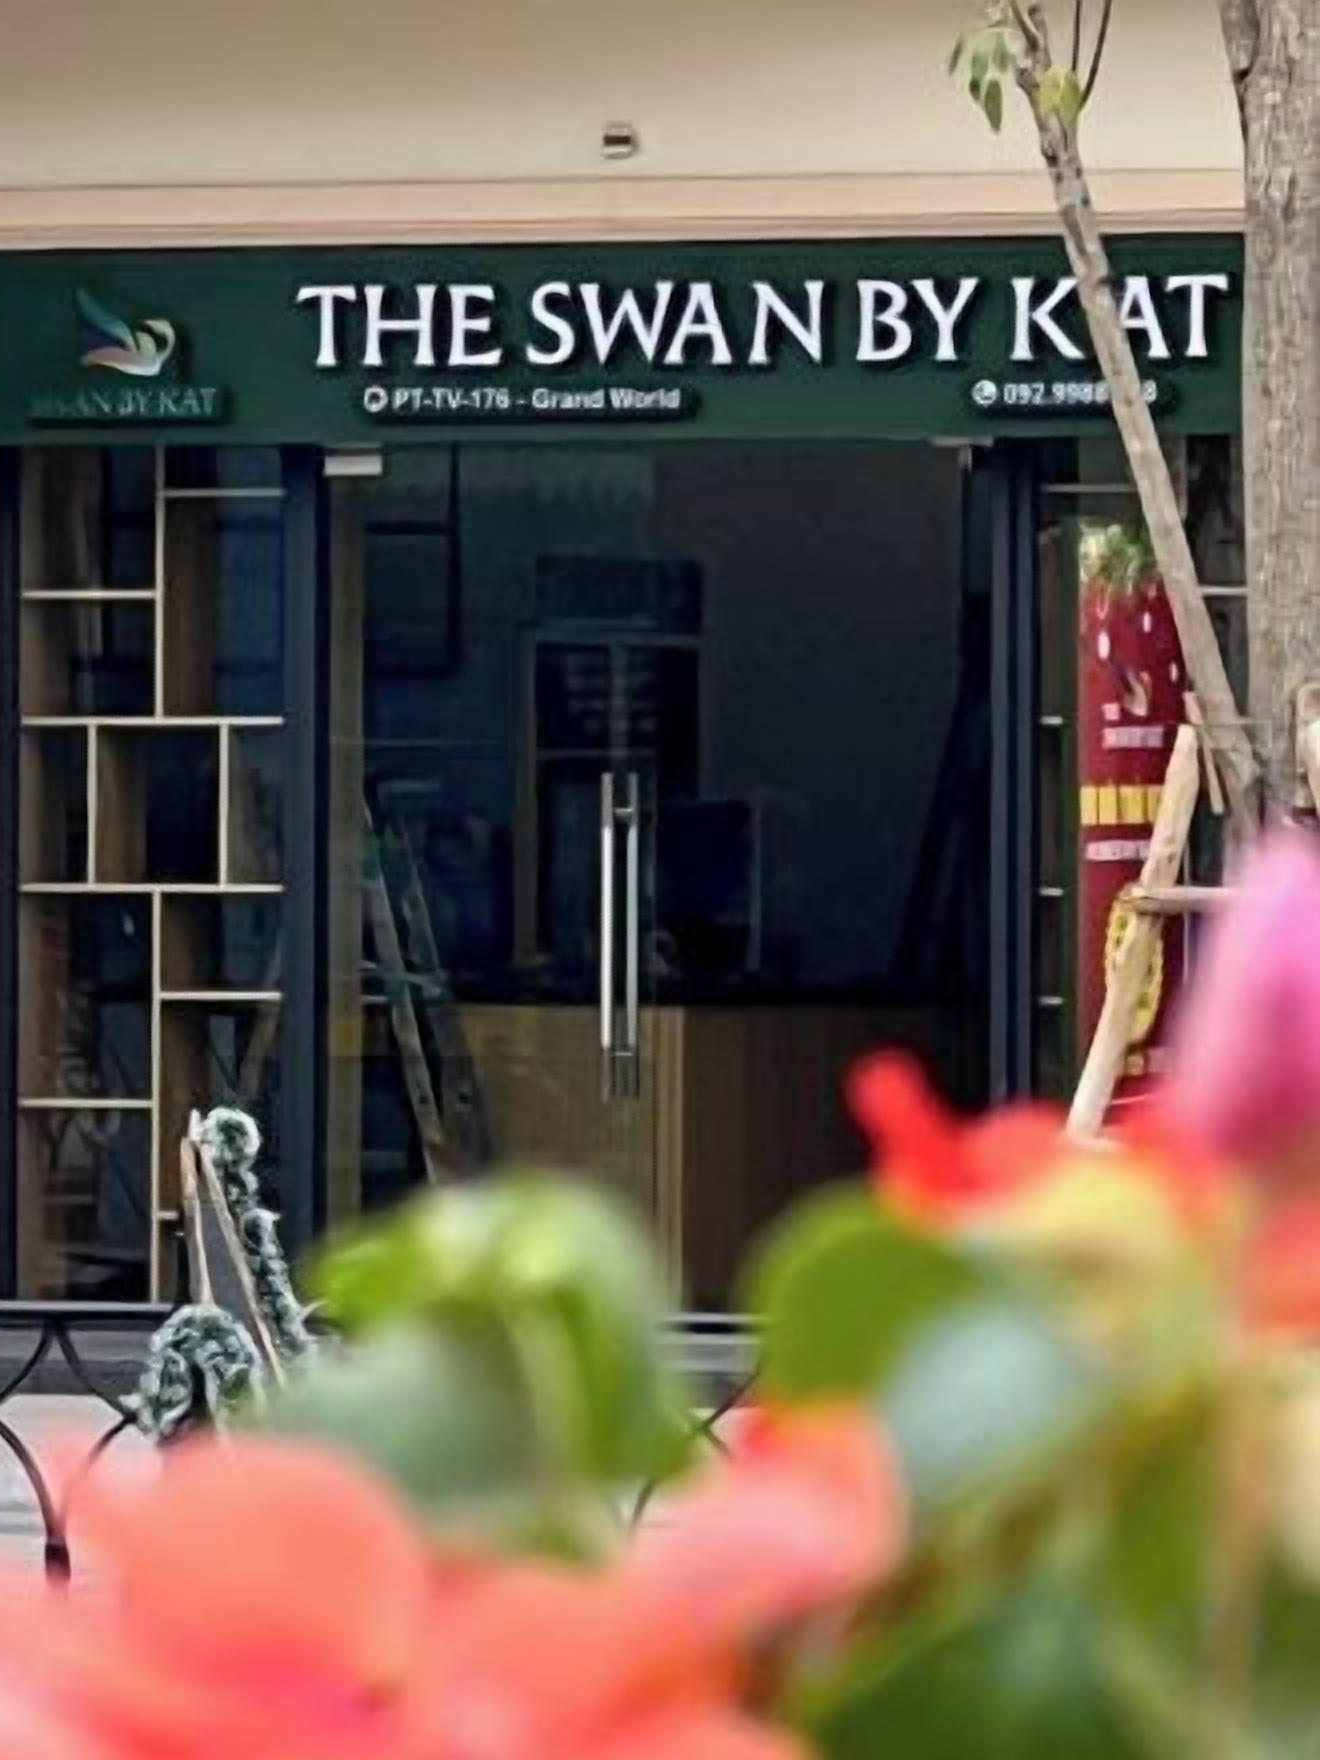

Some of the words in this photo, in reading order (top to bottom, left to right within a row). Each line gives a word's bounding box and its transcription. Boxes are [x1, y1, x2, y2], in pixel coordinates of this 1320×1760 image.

[296, 284, 503, 367] THE
[525, 280, 825, 367] SWAN
[855, 277, 979, 362] BY
[1010, 274, 1229, 360] KAT
[531, 386, 606, 410] Grand
[609, 386, 681, 410] World
